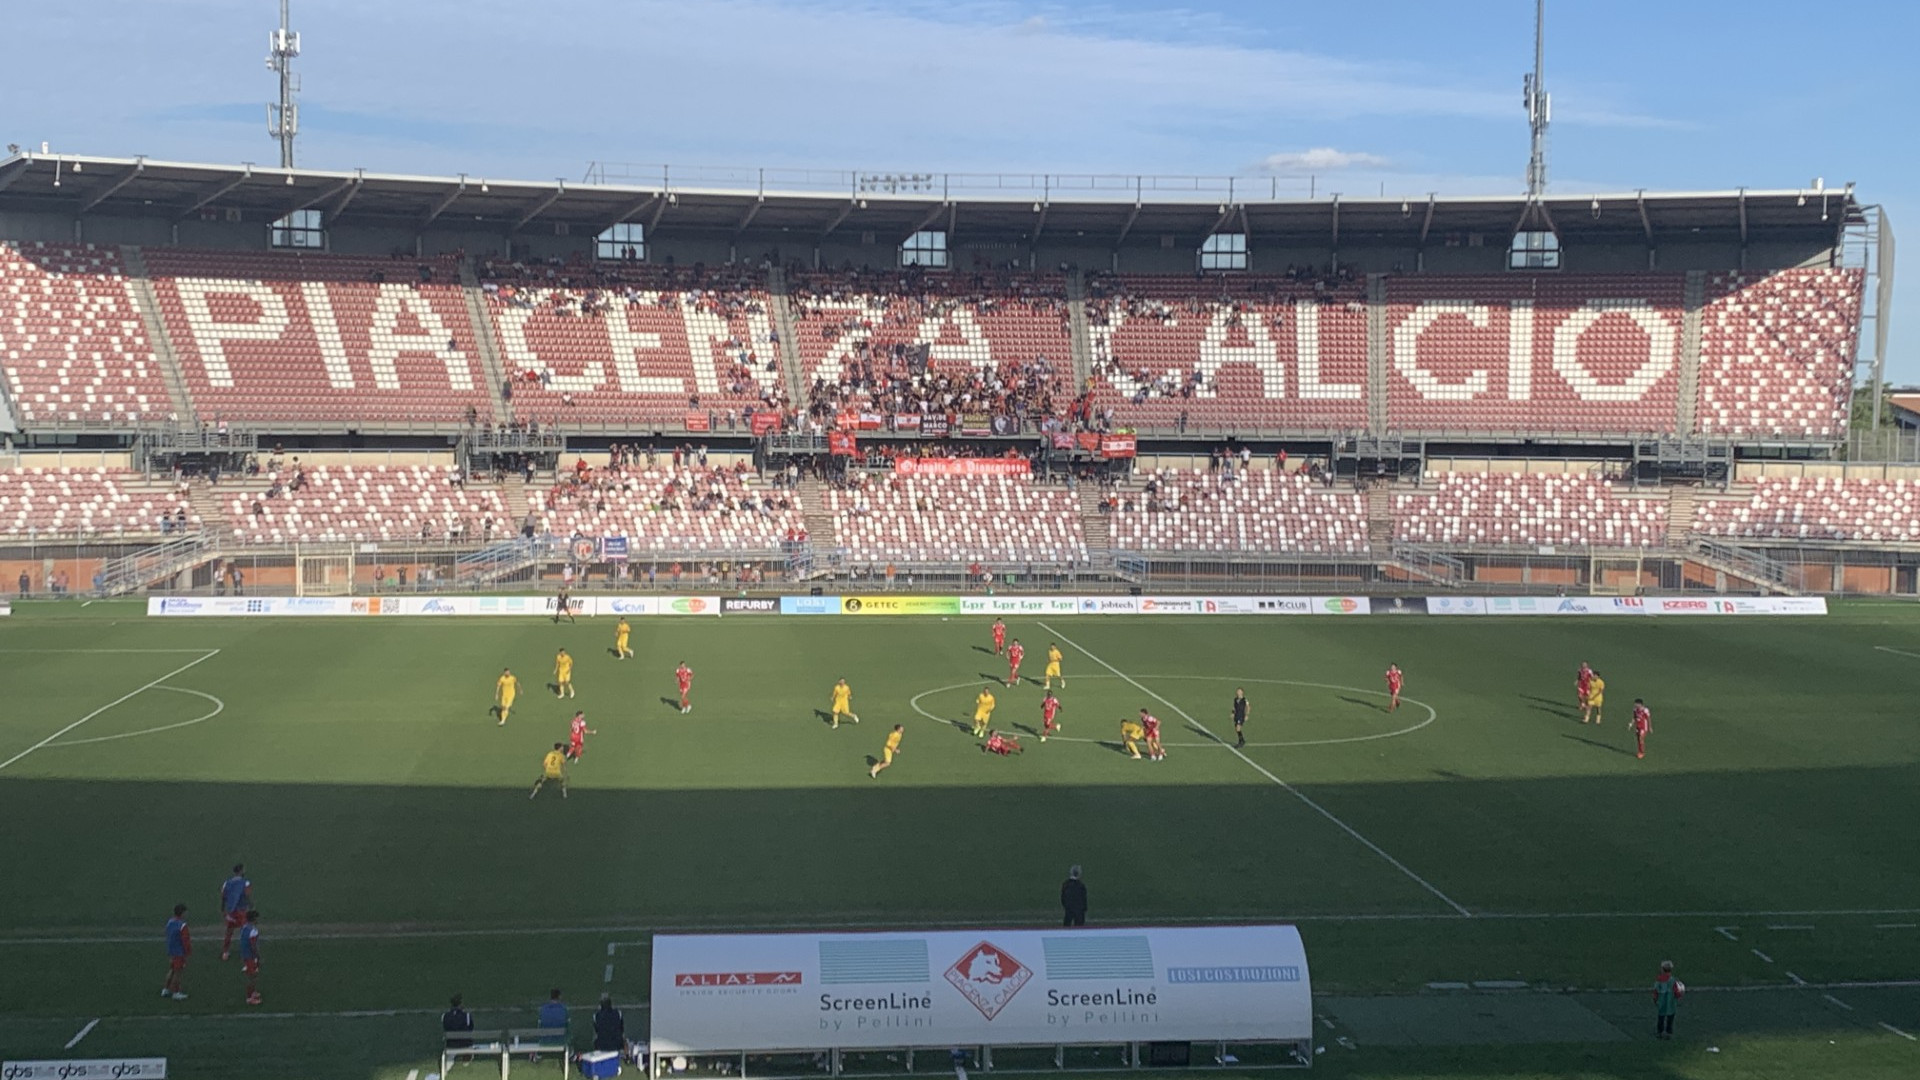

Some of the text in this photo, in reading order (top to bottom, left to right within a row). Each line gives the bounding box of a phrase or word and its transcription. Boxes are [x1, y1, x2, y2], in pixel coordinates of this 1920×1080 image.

[173, 276, 1676, 402] PIACENZA CALCIO
[624, 604, 645, 613] CMI
[726, 600, 774, 610] REFURBY
[962, 600, 985, 610] Lpr
[993, 600, 1016, 610] Lpr
[1020, 600, 1044, 610] Lpr
[1051, 600, 1074, 610] Lpr
[1100, 600, 1134, 610] jobtech
[1662, 601, 1708, 610] KZERO
[680, 974, 756, 986] ALIAS
[1171, 966, 1297, 982] LOSI COSTRUZIONI
[949, 968, 1029, 1016] PIACENZA CALCIO
[1047, 988, 1157, 1006] ScreenLine
[820, 993, 932, 1011] ScreenLine
[820, 1015, 933, 1031] by Pellini
[1047, 1010, 1158, 1027] by Pellini
[4, 1064, 33, 1080] gbs
[58, 1063, 87, 1079] gbs
[111, 1062, 141, 1078] gbs
